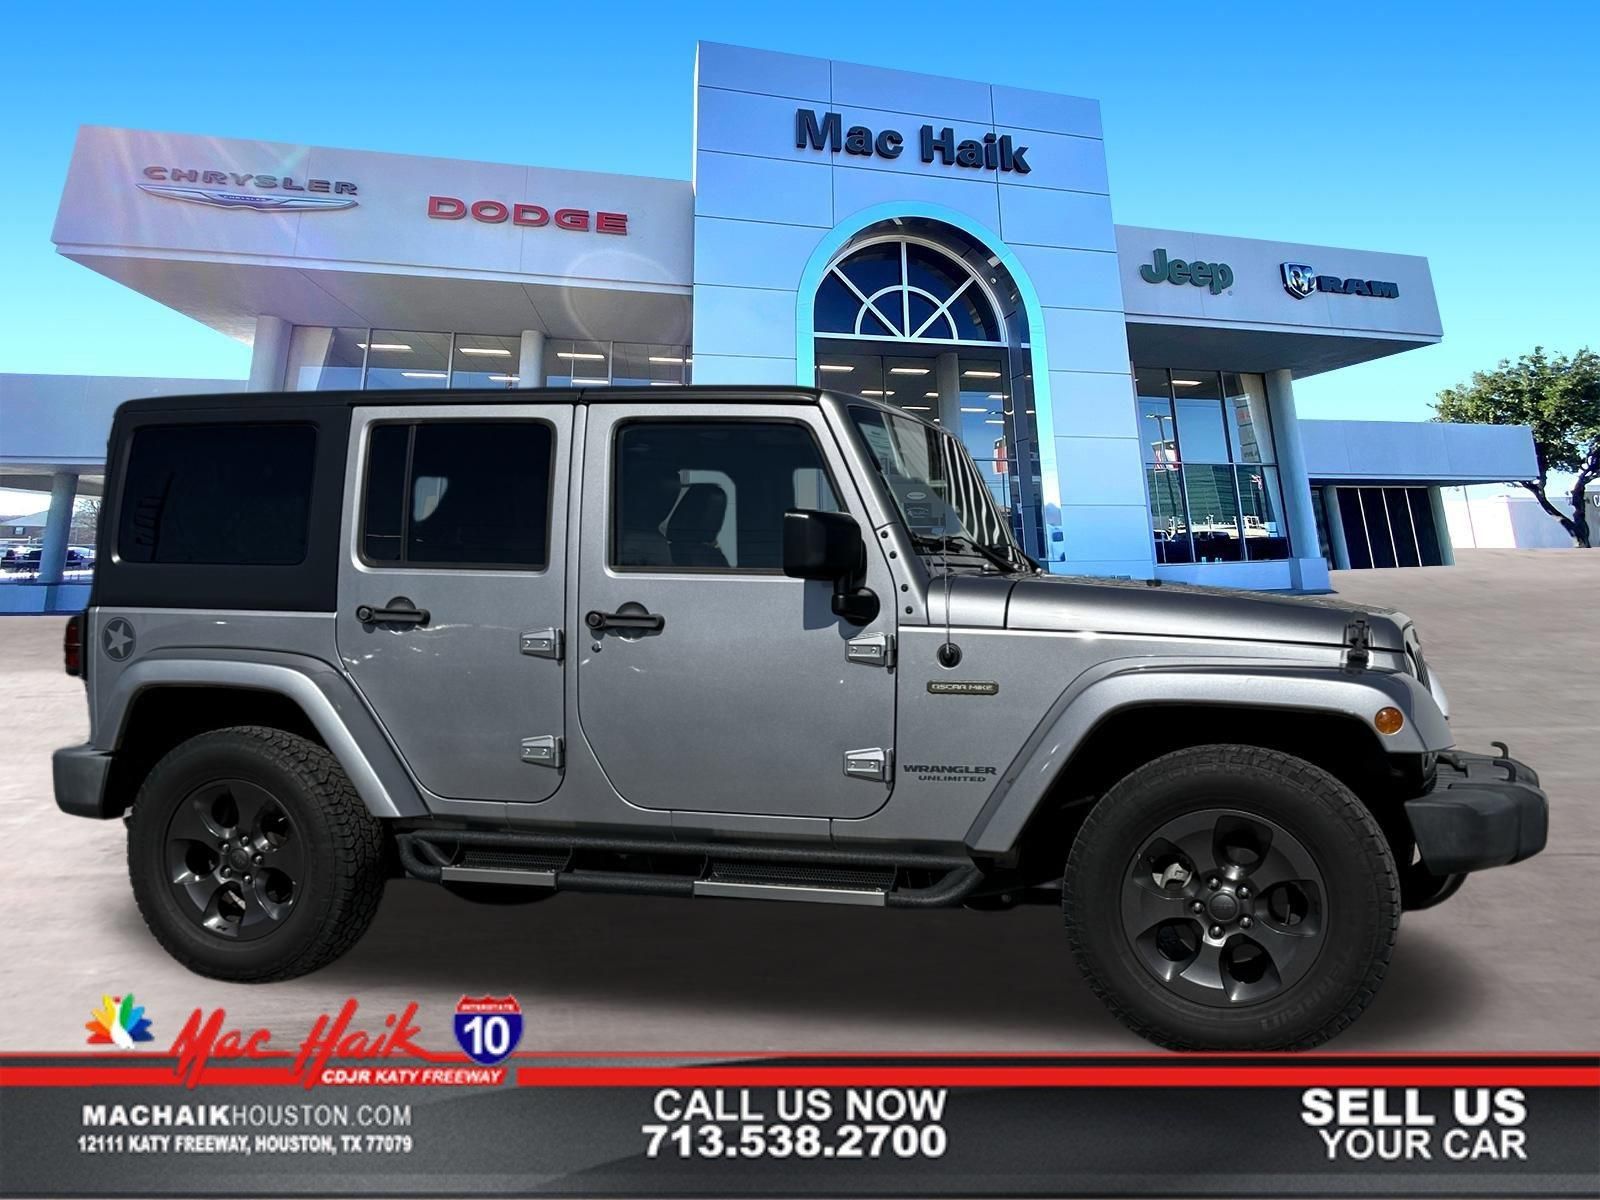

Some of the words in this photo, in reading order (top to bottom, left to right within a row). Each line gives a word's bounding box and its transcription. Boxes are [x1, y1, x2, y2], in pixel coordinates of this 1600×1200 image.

[796, 108, 904, 159] Mac
[920, 124, 1032, 174] Haik
[143, 166, 359, 195] CHRYSLER
[428, 196, 628, 236] DODGE
[1140, 248, 1234, 296] Jeep
[1316, 275, 1400, 299] RAM
[931, 683, 967, 691] OSCAR
[968, 684, 993, 692] MIKE
[903, 765, 997, 775] WRANGLER
